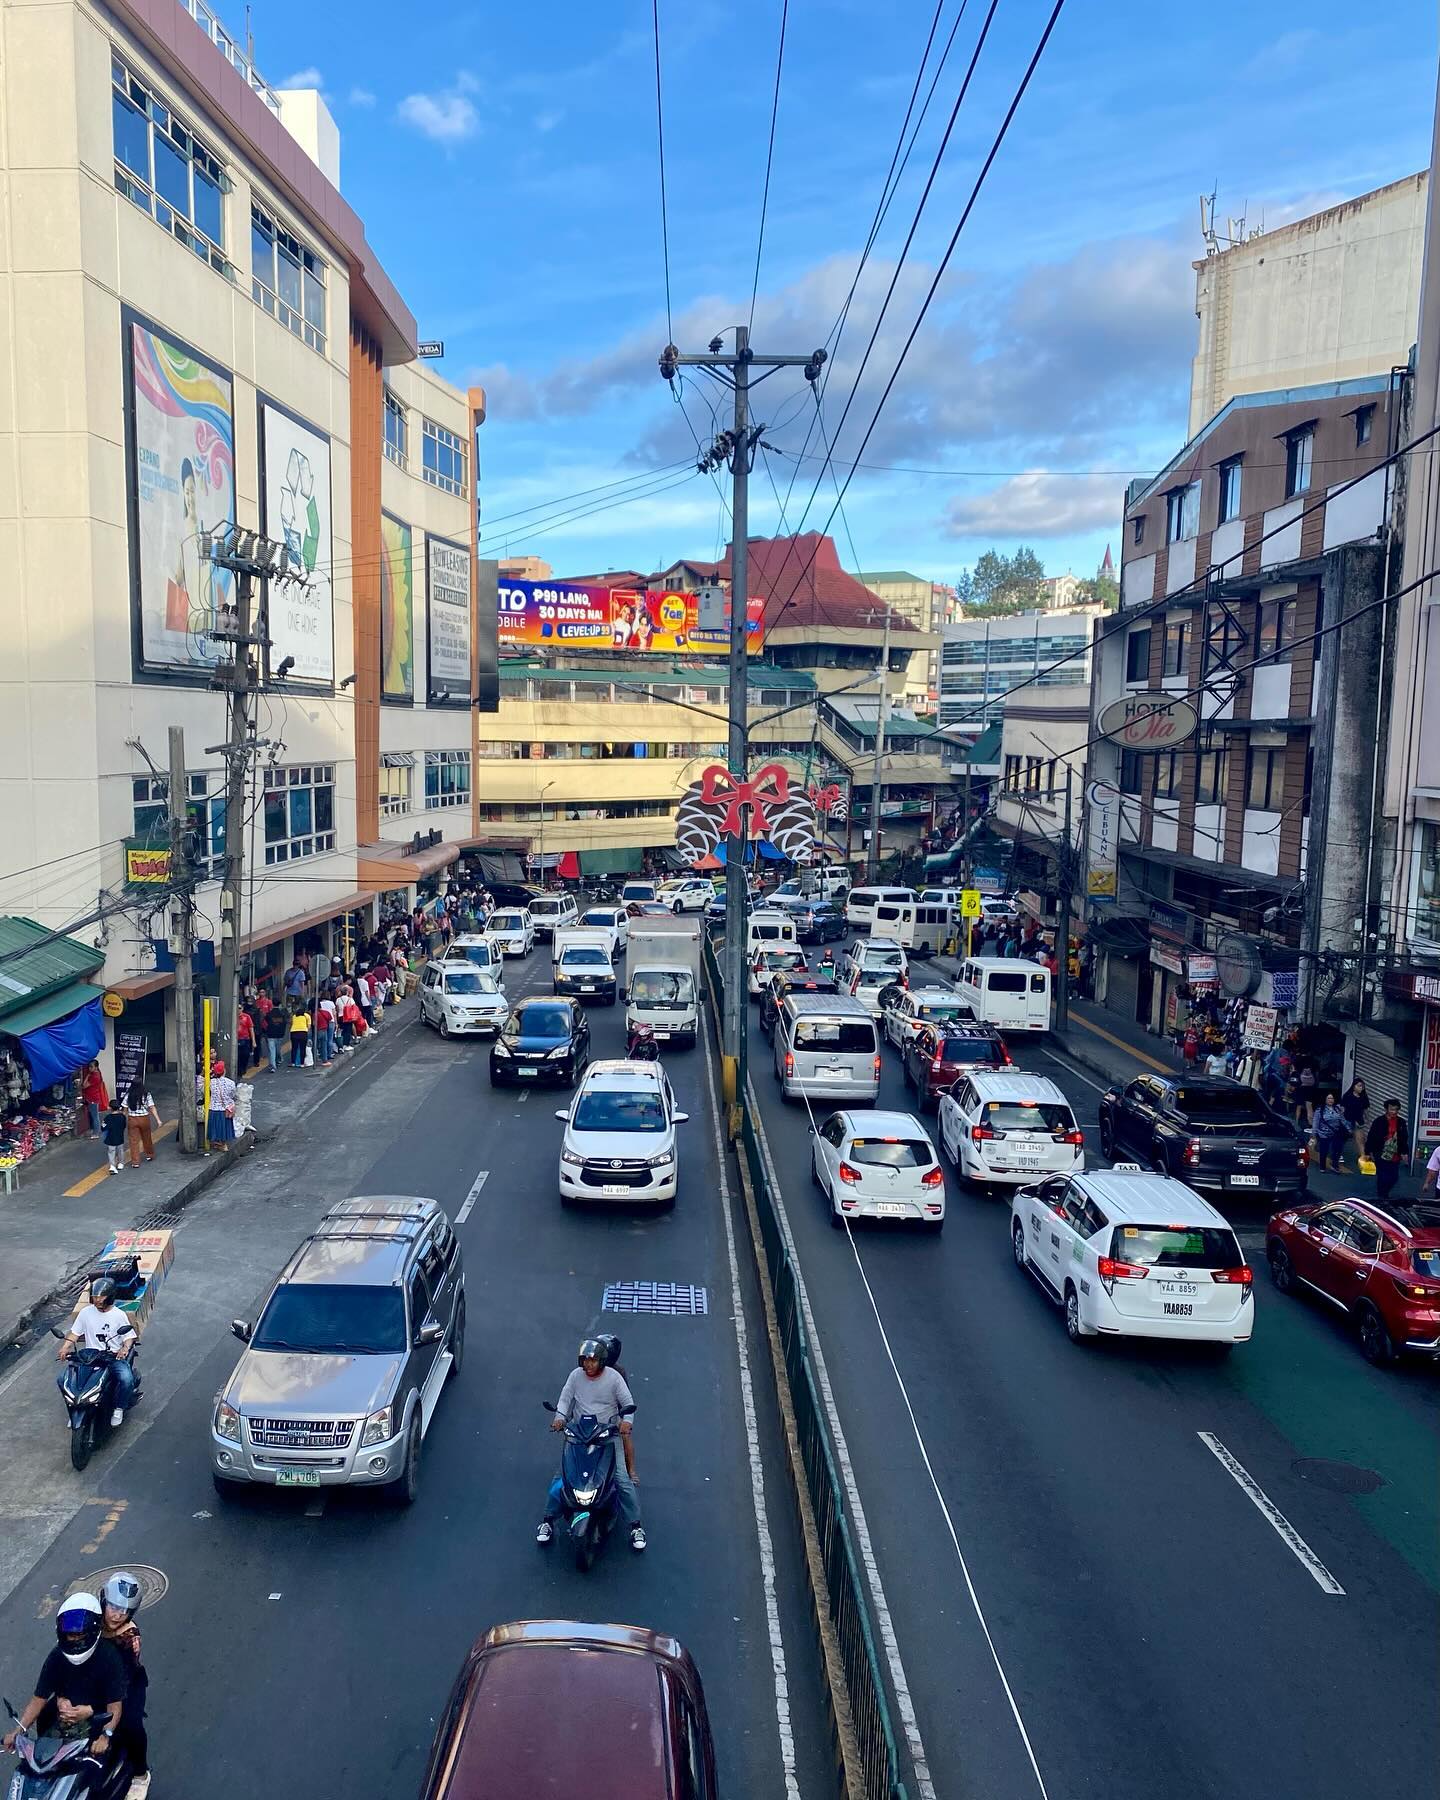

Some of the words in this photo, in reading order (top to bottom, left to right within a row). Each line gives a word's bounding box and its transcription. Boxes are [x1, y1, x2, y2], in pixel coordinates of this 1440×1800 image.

[539, 606, 556, 618] 30
[557, 608, 586, 620] DAYS
[663, 606, 684, 619] 7GB
[1125, 703, 1174, 716] HOTEL
[1101, 806, 1109, 859] CEBUANA
[1250, 1010, 1274, 1019] LOADING
[1247, 1021, 1273, 1032] UNLOADING
[1161, 1283, 1175, 1292] YAA
[1179, 1284, 1197, 1294] 8859
[1163, 1302, 1193, 1316] YAA8859
[279, 1471, 296, 1482] ZML
[301, 1472, 318, 1482] 708
